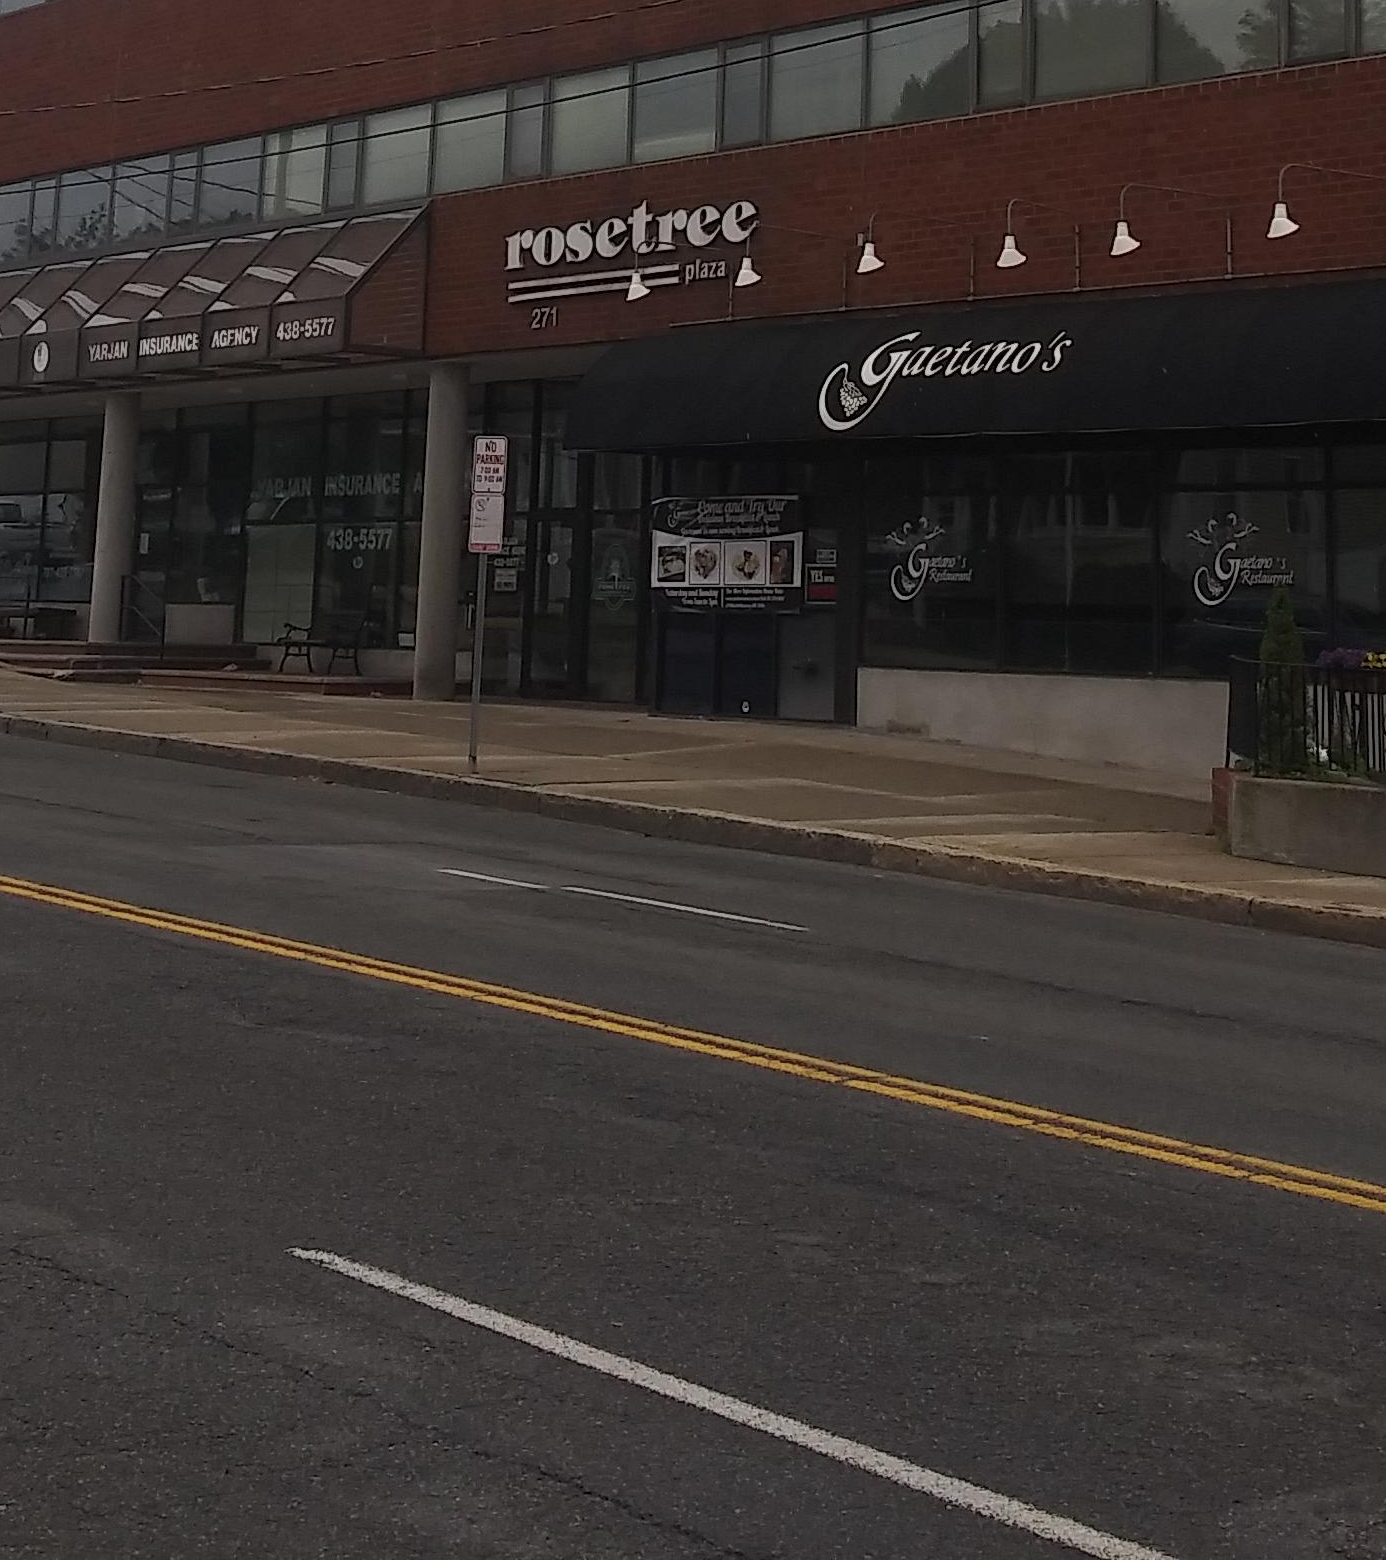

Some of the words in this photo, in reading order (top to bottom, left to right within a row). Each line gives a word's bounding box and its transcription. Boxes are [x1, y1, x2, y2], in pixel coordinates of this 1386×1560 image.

[504, 200, 760, 271] rosetree
[684, 258, 727, 285] plaza
[529, 306, 559, 329] 271
[88, 340, 130, 363] YARJAN
[138, 332, 200, 357] INSURANCE
[210, 326, 260, 350] AGENCY
[276, 317, 335, 341] 438-5577
[818, 330, 1073, 431] Gaetano's
[485, 440, 497, 453] NO
[476, 454, 505, 465] PARKING
[323, 472, 401, 497] INSURANCE
[326, 527, 393, 551] 438-5577
[1239, 569, 1294, 586] Restaurant
